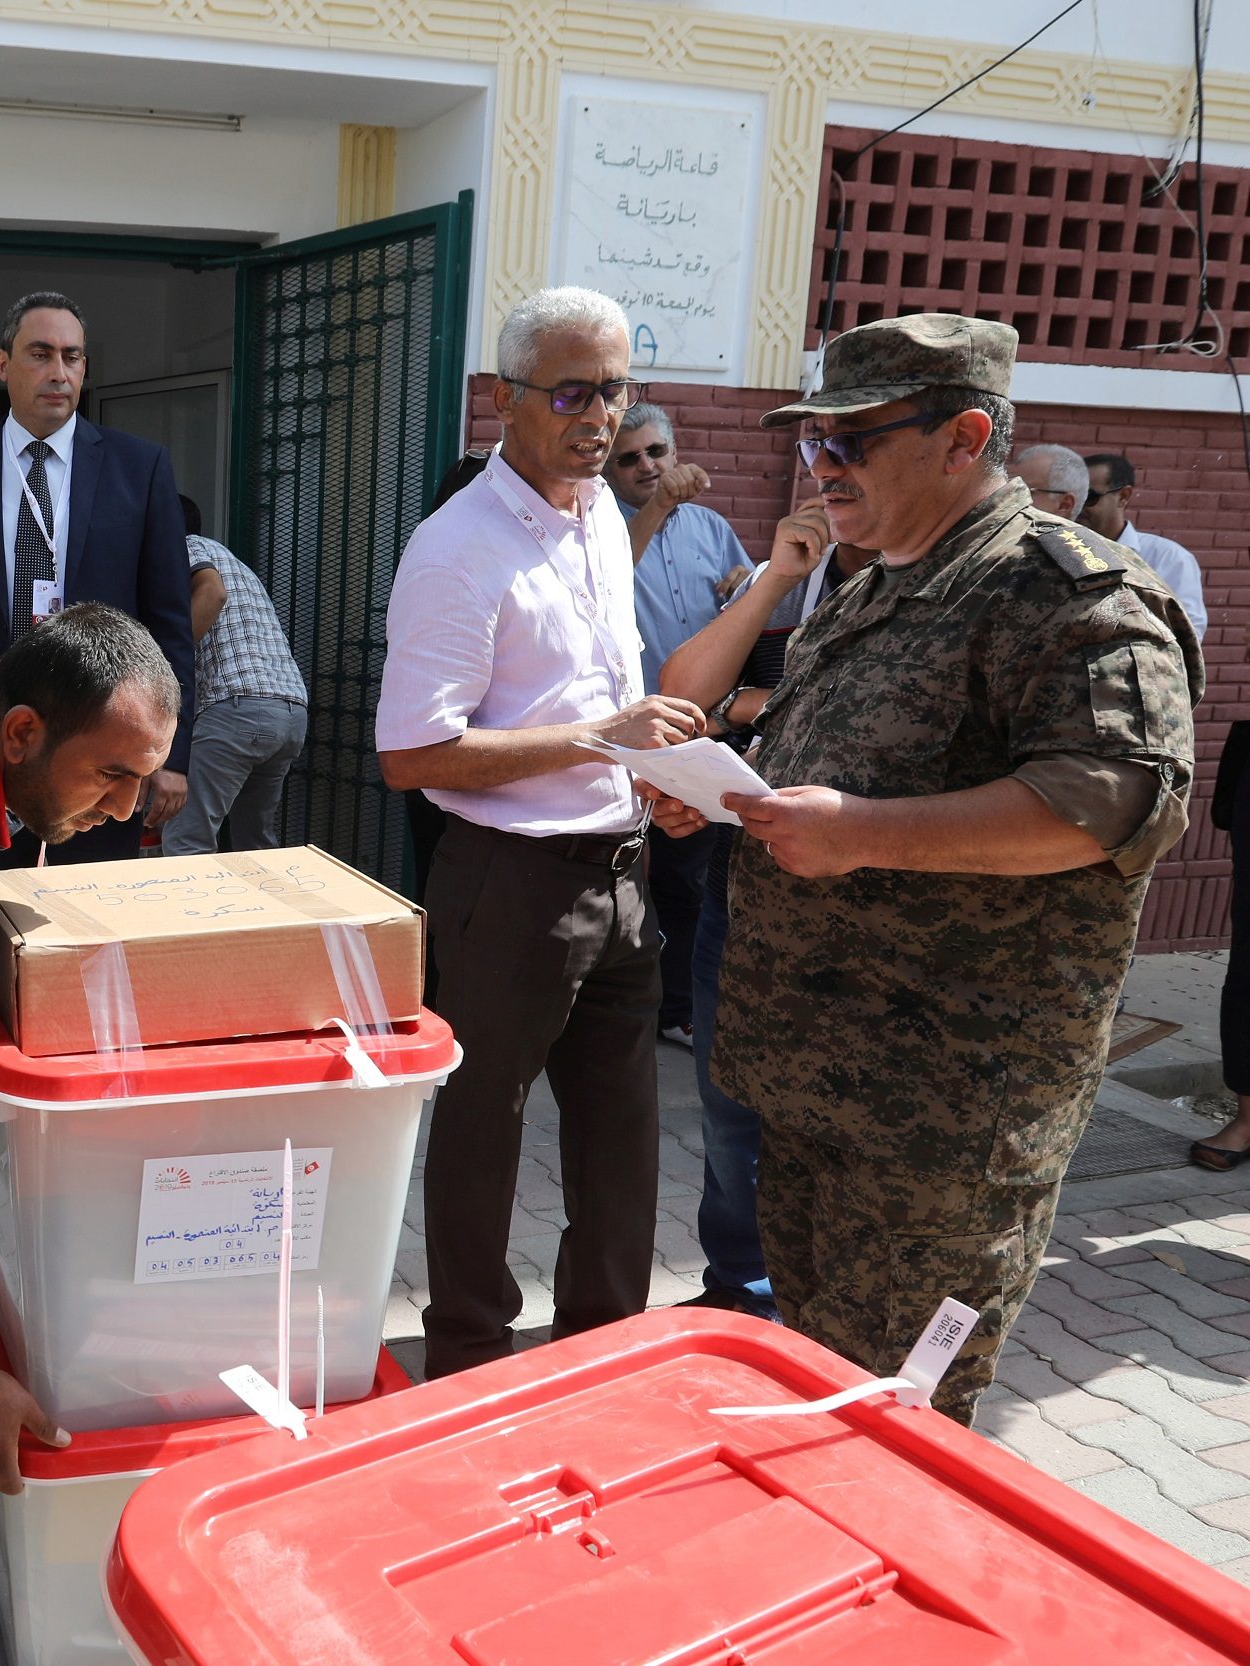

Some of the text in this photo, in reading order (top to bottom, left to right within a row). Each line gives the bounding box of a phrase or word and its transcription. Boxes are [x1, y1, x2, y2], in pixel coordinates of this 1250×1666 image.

[595, 142, 718, 176] قاعة الرياضة
[683, 254, 710, 278] وقع
[928, 1313, 953, 1347] 206041
[939, 1319, 964, 1350] ISIE
